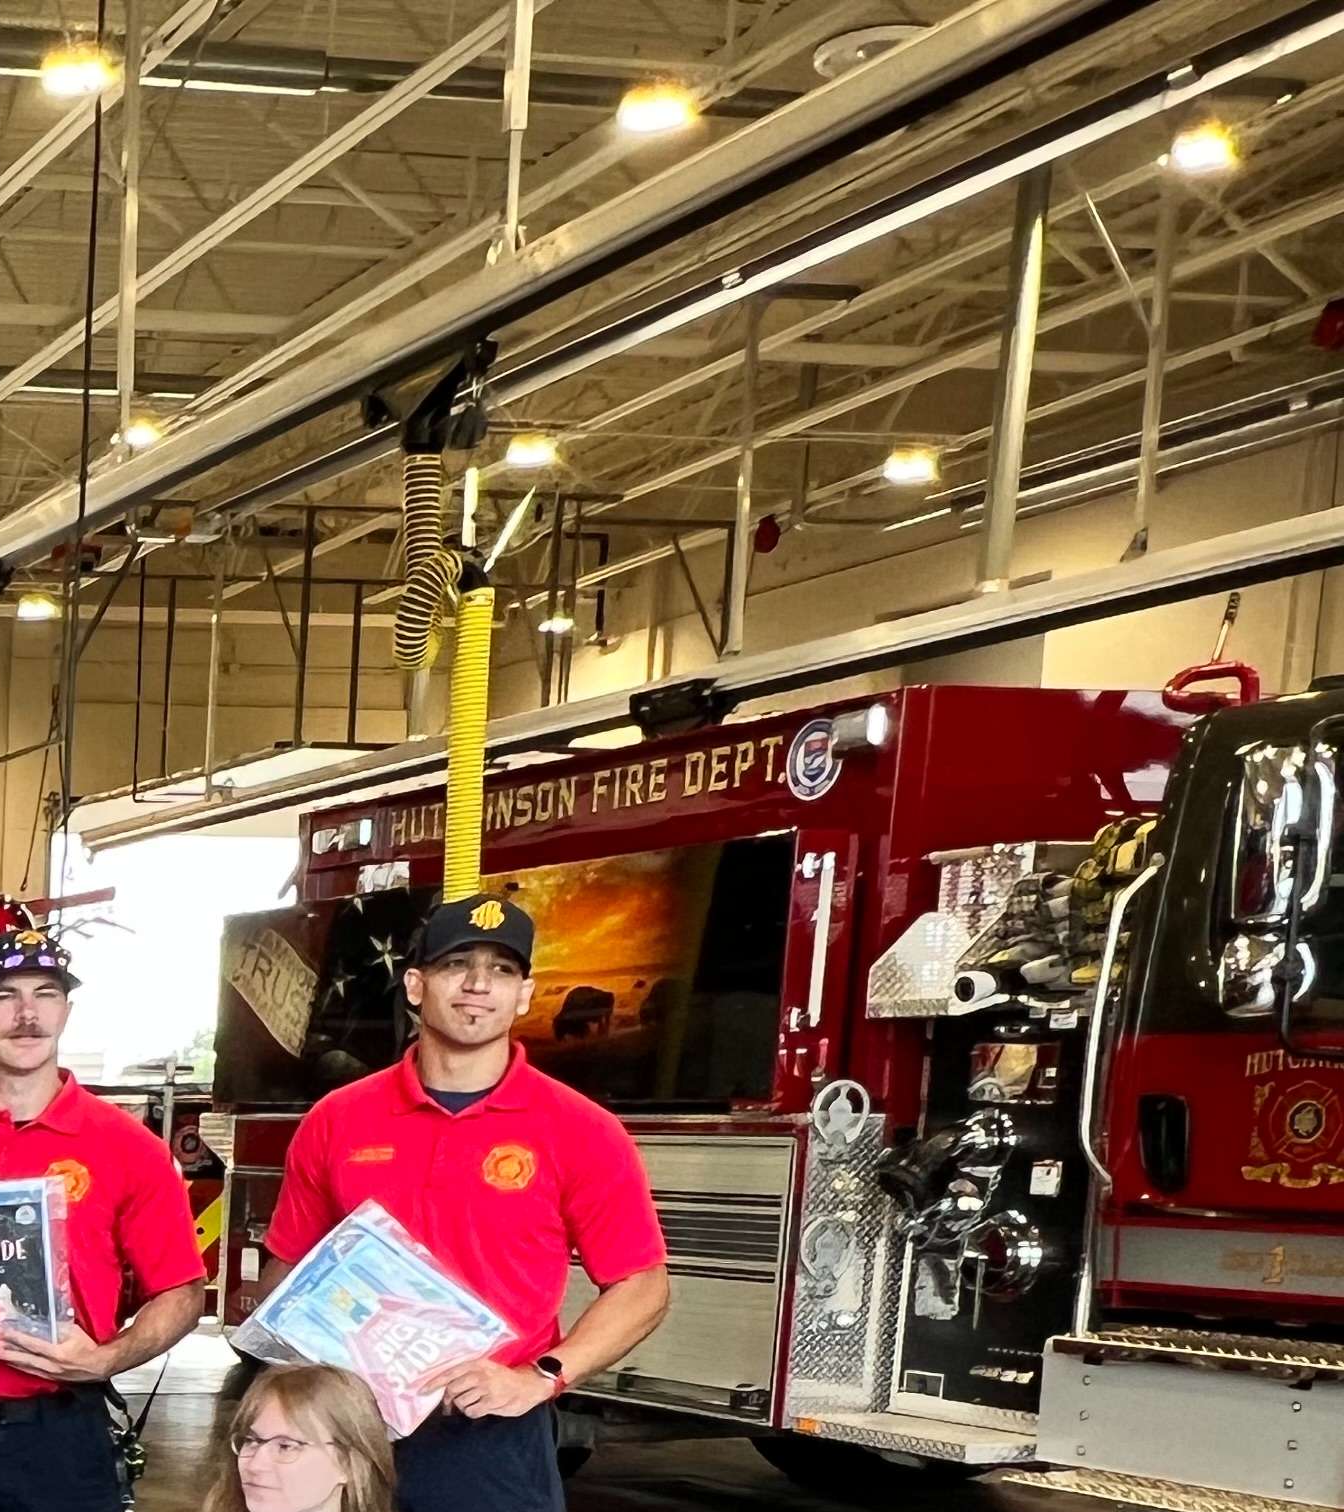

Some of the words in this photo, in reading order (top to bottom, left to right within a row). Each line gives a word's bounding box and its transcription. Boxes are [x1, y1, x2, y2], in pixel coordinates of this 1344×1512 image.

[389, 776, 579, 848] HUTINSON
[591, 758, 669, 814] FIRE
[681, 735, 787, 798] DEPT.
